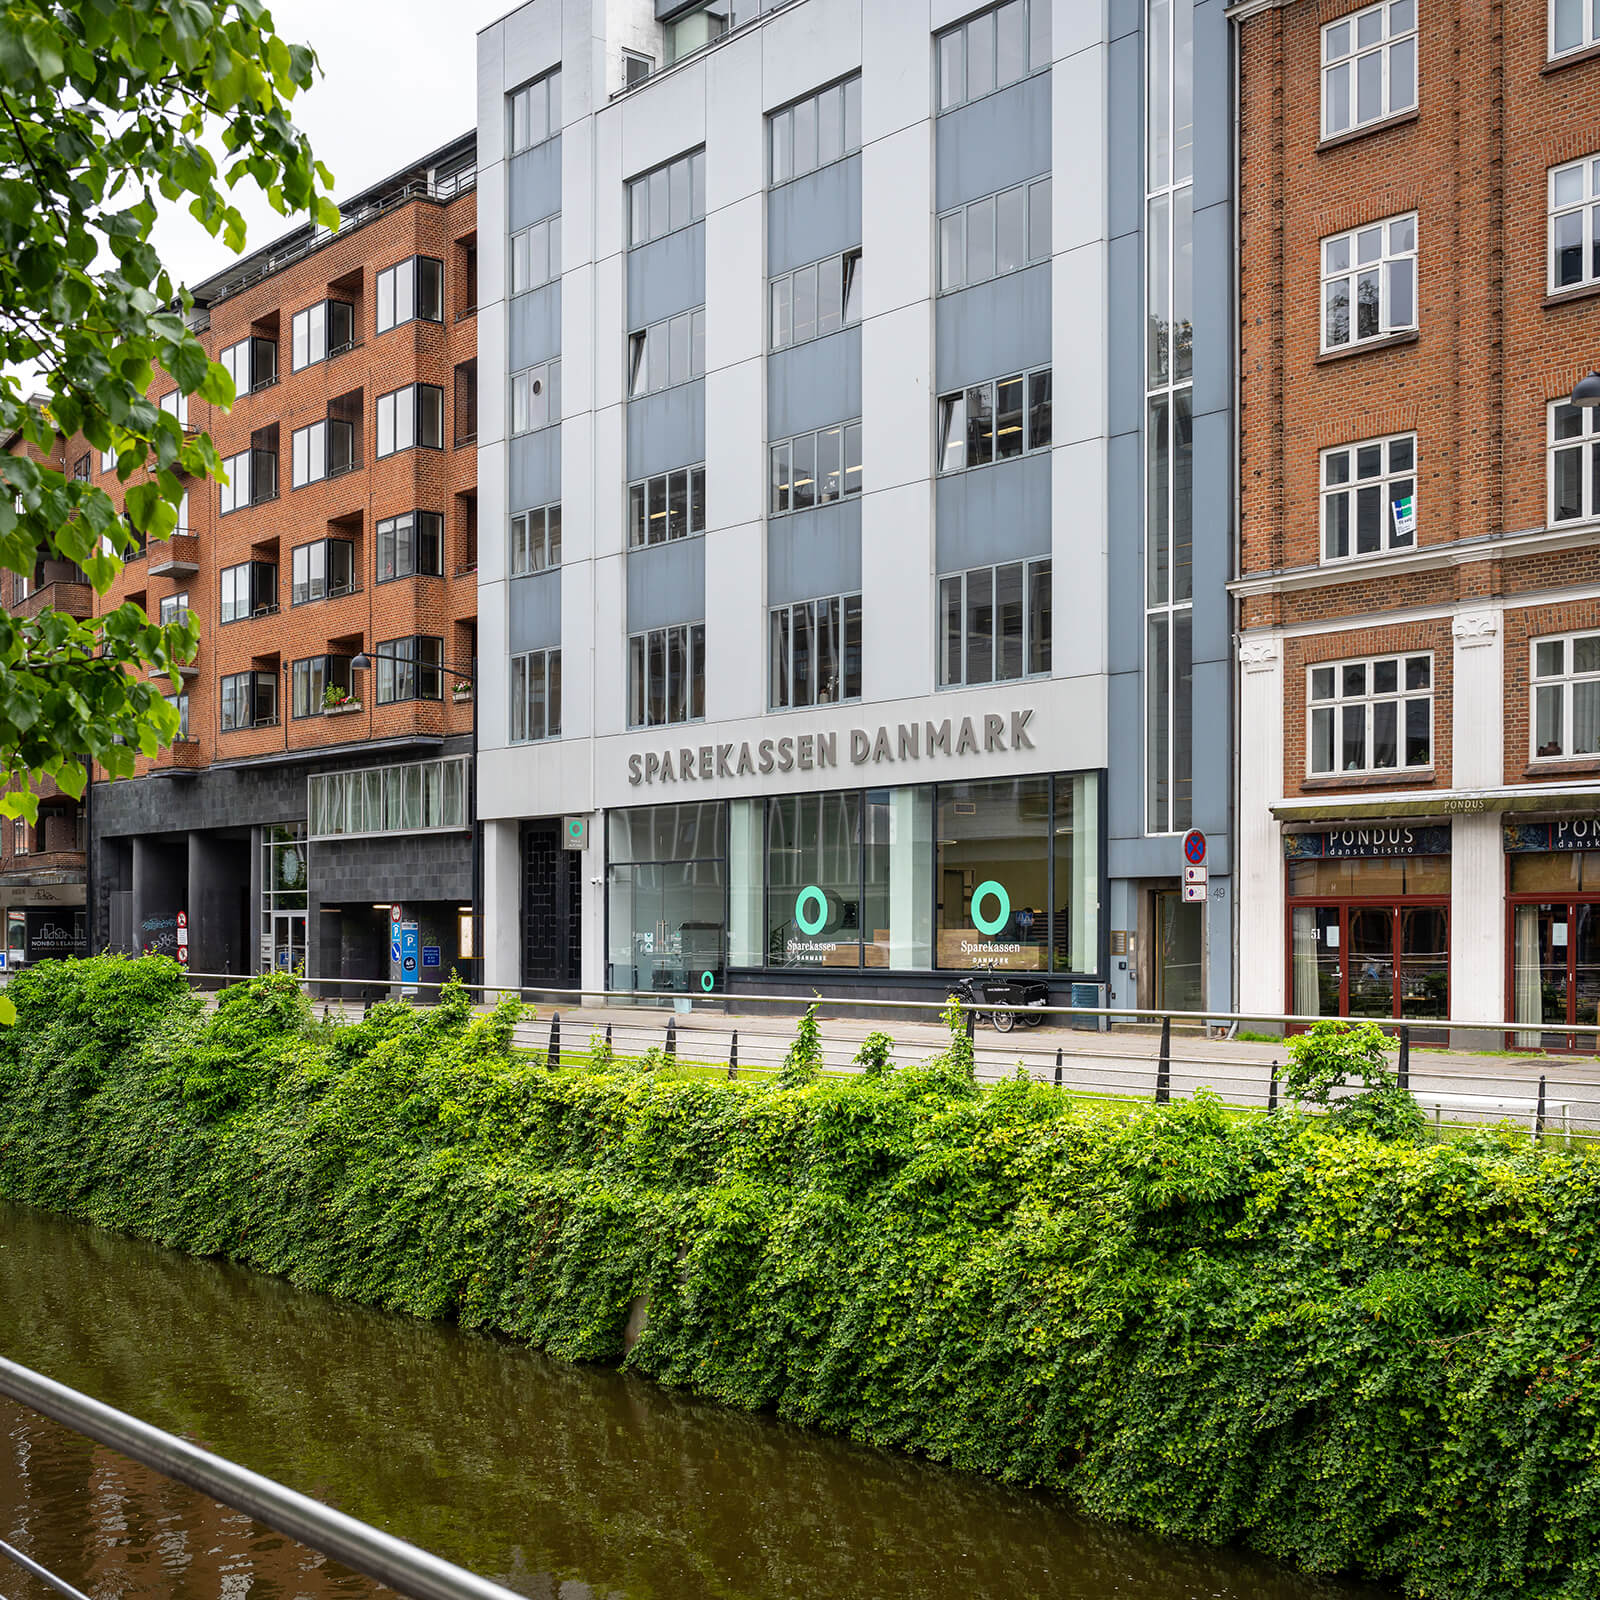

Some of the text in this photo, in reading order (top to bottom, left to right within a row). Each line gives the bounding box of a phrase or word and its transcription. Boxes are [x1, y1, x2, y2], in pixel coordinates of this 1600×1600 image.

[628, 709, 1036, 785] SPAREKASSEN DANMARK
[1444, 800, 1484, 809] PONDUS
[1329, 828, 1414, 846] PONDUS
[1329, 845, 1413, 856] dansk bistro
[1213, 887, 1225, 898] 49
[1310, 928, 1321, 940] 51
[786, 939, 837, 954] Sparekassen
[960, 940, 1020, 954] Sparekassen
